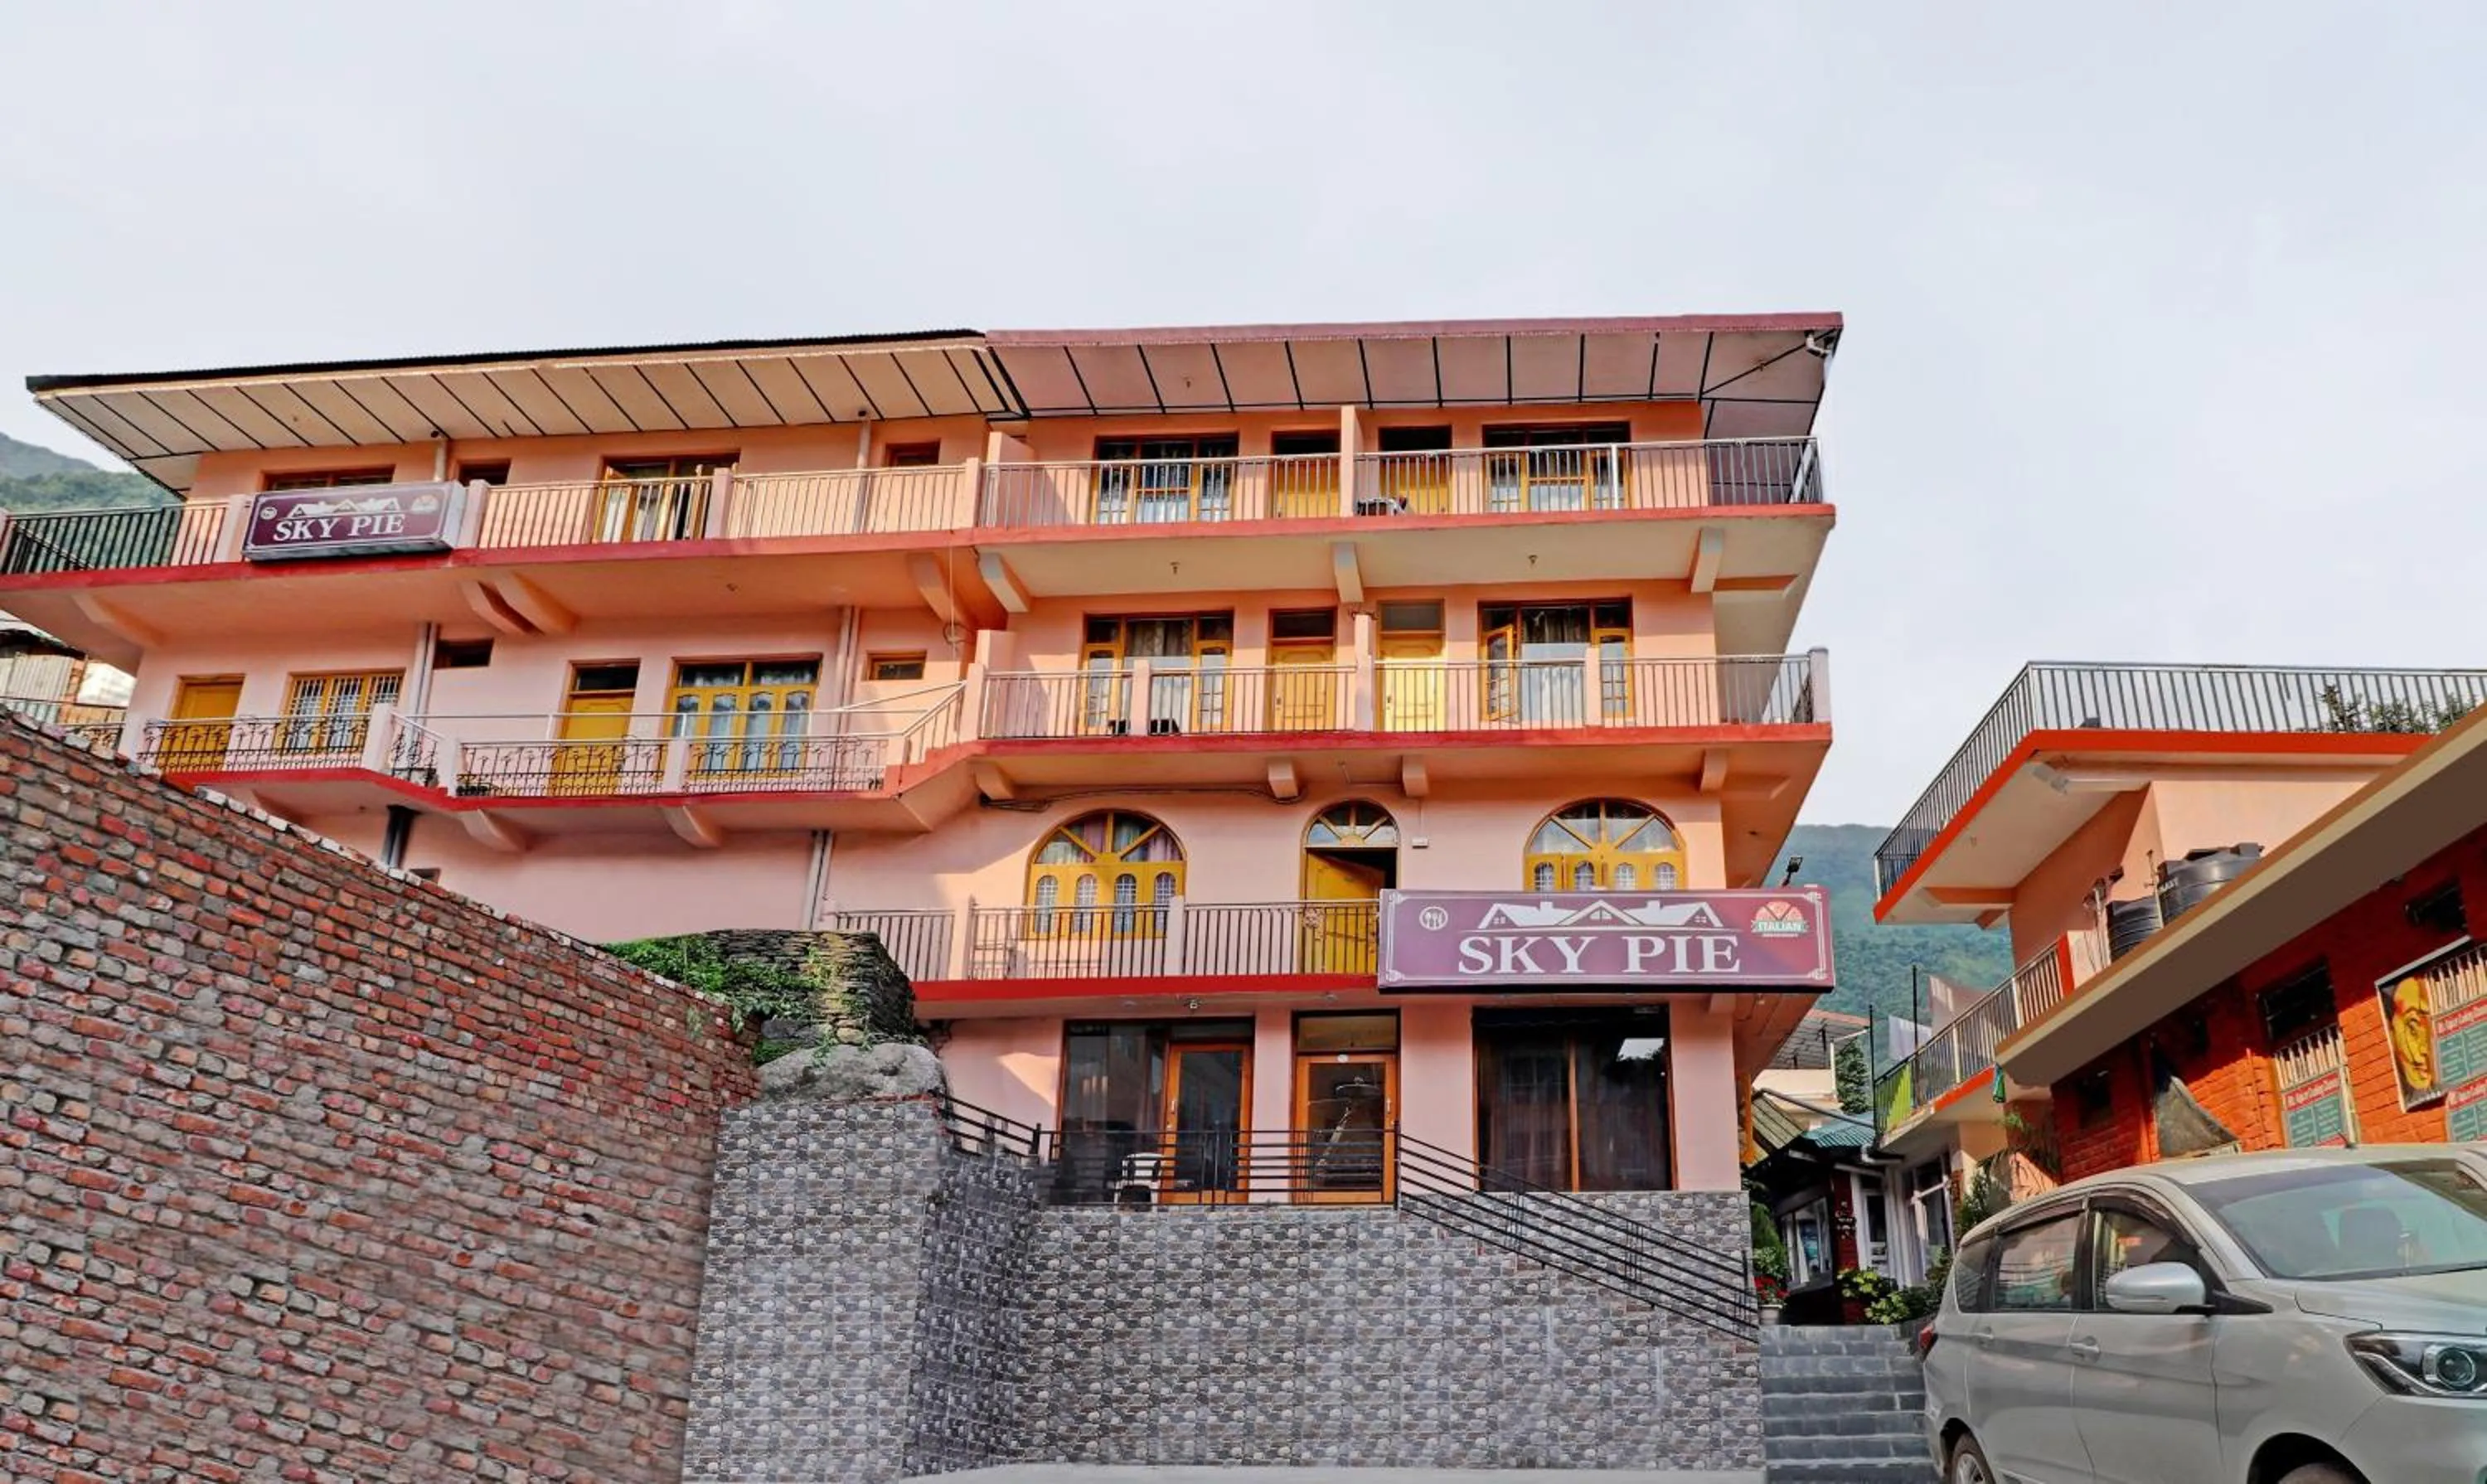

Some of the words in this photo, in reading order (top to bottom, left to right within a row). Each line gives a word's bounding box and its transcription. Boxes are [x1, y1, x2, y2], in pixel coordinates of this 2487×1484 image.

[273, 516, 341, 542] SKY
[347, 513, 405, 537] PIE
[1757, 921, 1804, 931] ITALIAN
[1457, 935, 1597, 975] SKY
[1622, 935, 1740, 975] PIE
